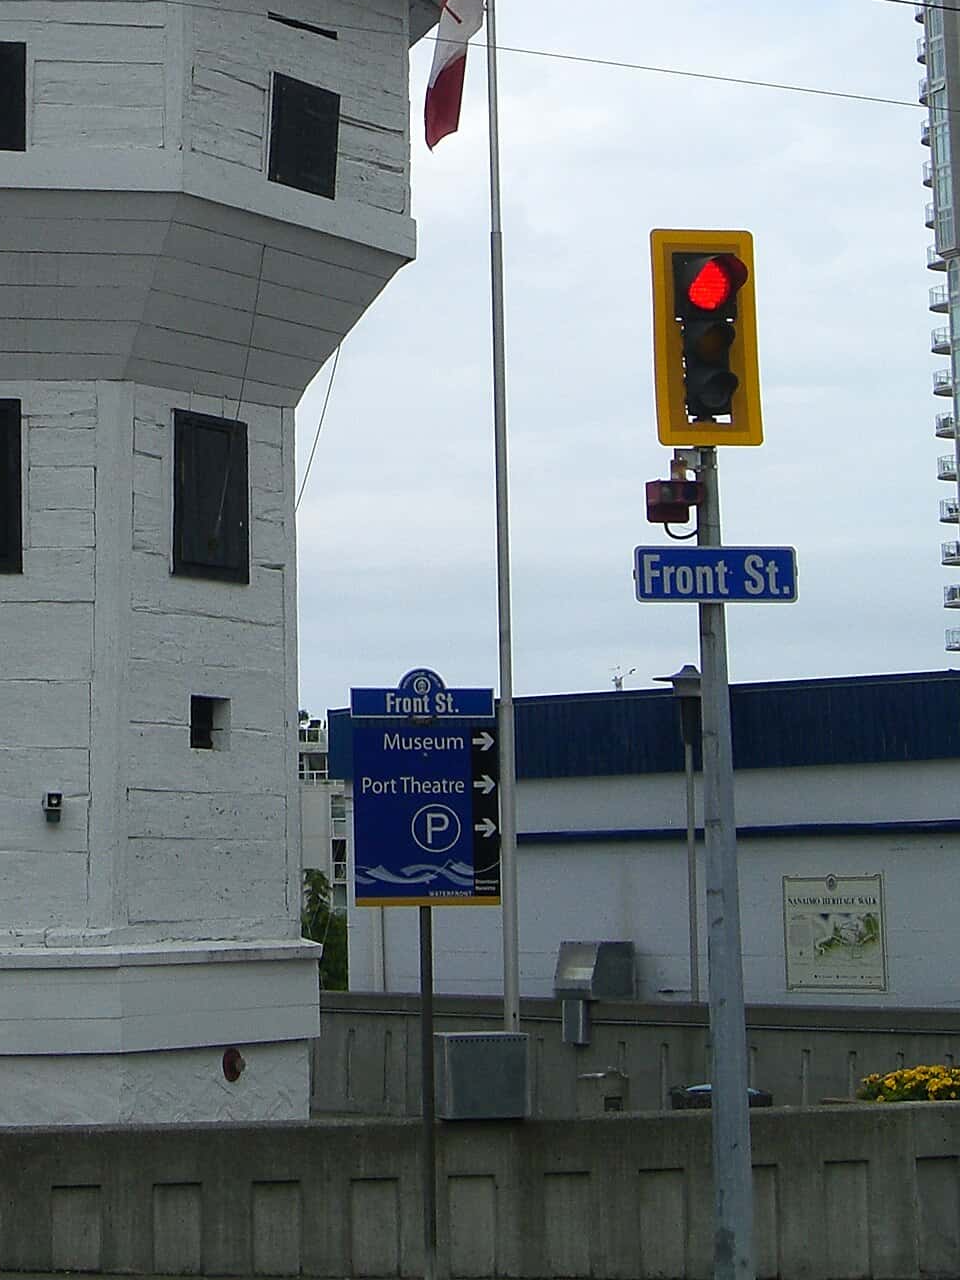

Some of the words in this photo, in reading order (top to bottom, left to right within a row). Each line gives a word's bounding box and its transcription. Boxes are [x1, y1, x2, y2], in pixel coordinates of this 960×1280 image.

[643, 554, 729, 594] Front
[744, 554, 790, 594] St.
[386, 693, 430, 713] Front
[435, 693, 459, 713] St.
[384, 733, 464, 750] Museum
[362, 777, 397, 794] Port
[400, 777, 465, 794] Theatre
[427, 813, 449, 844] P
[787, 897, 820, 905] NANAIMO
